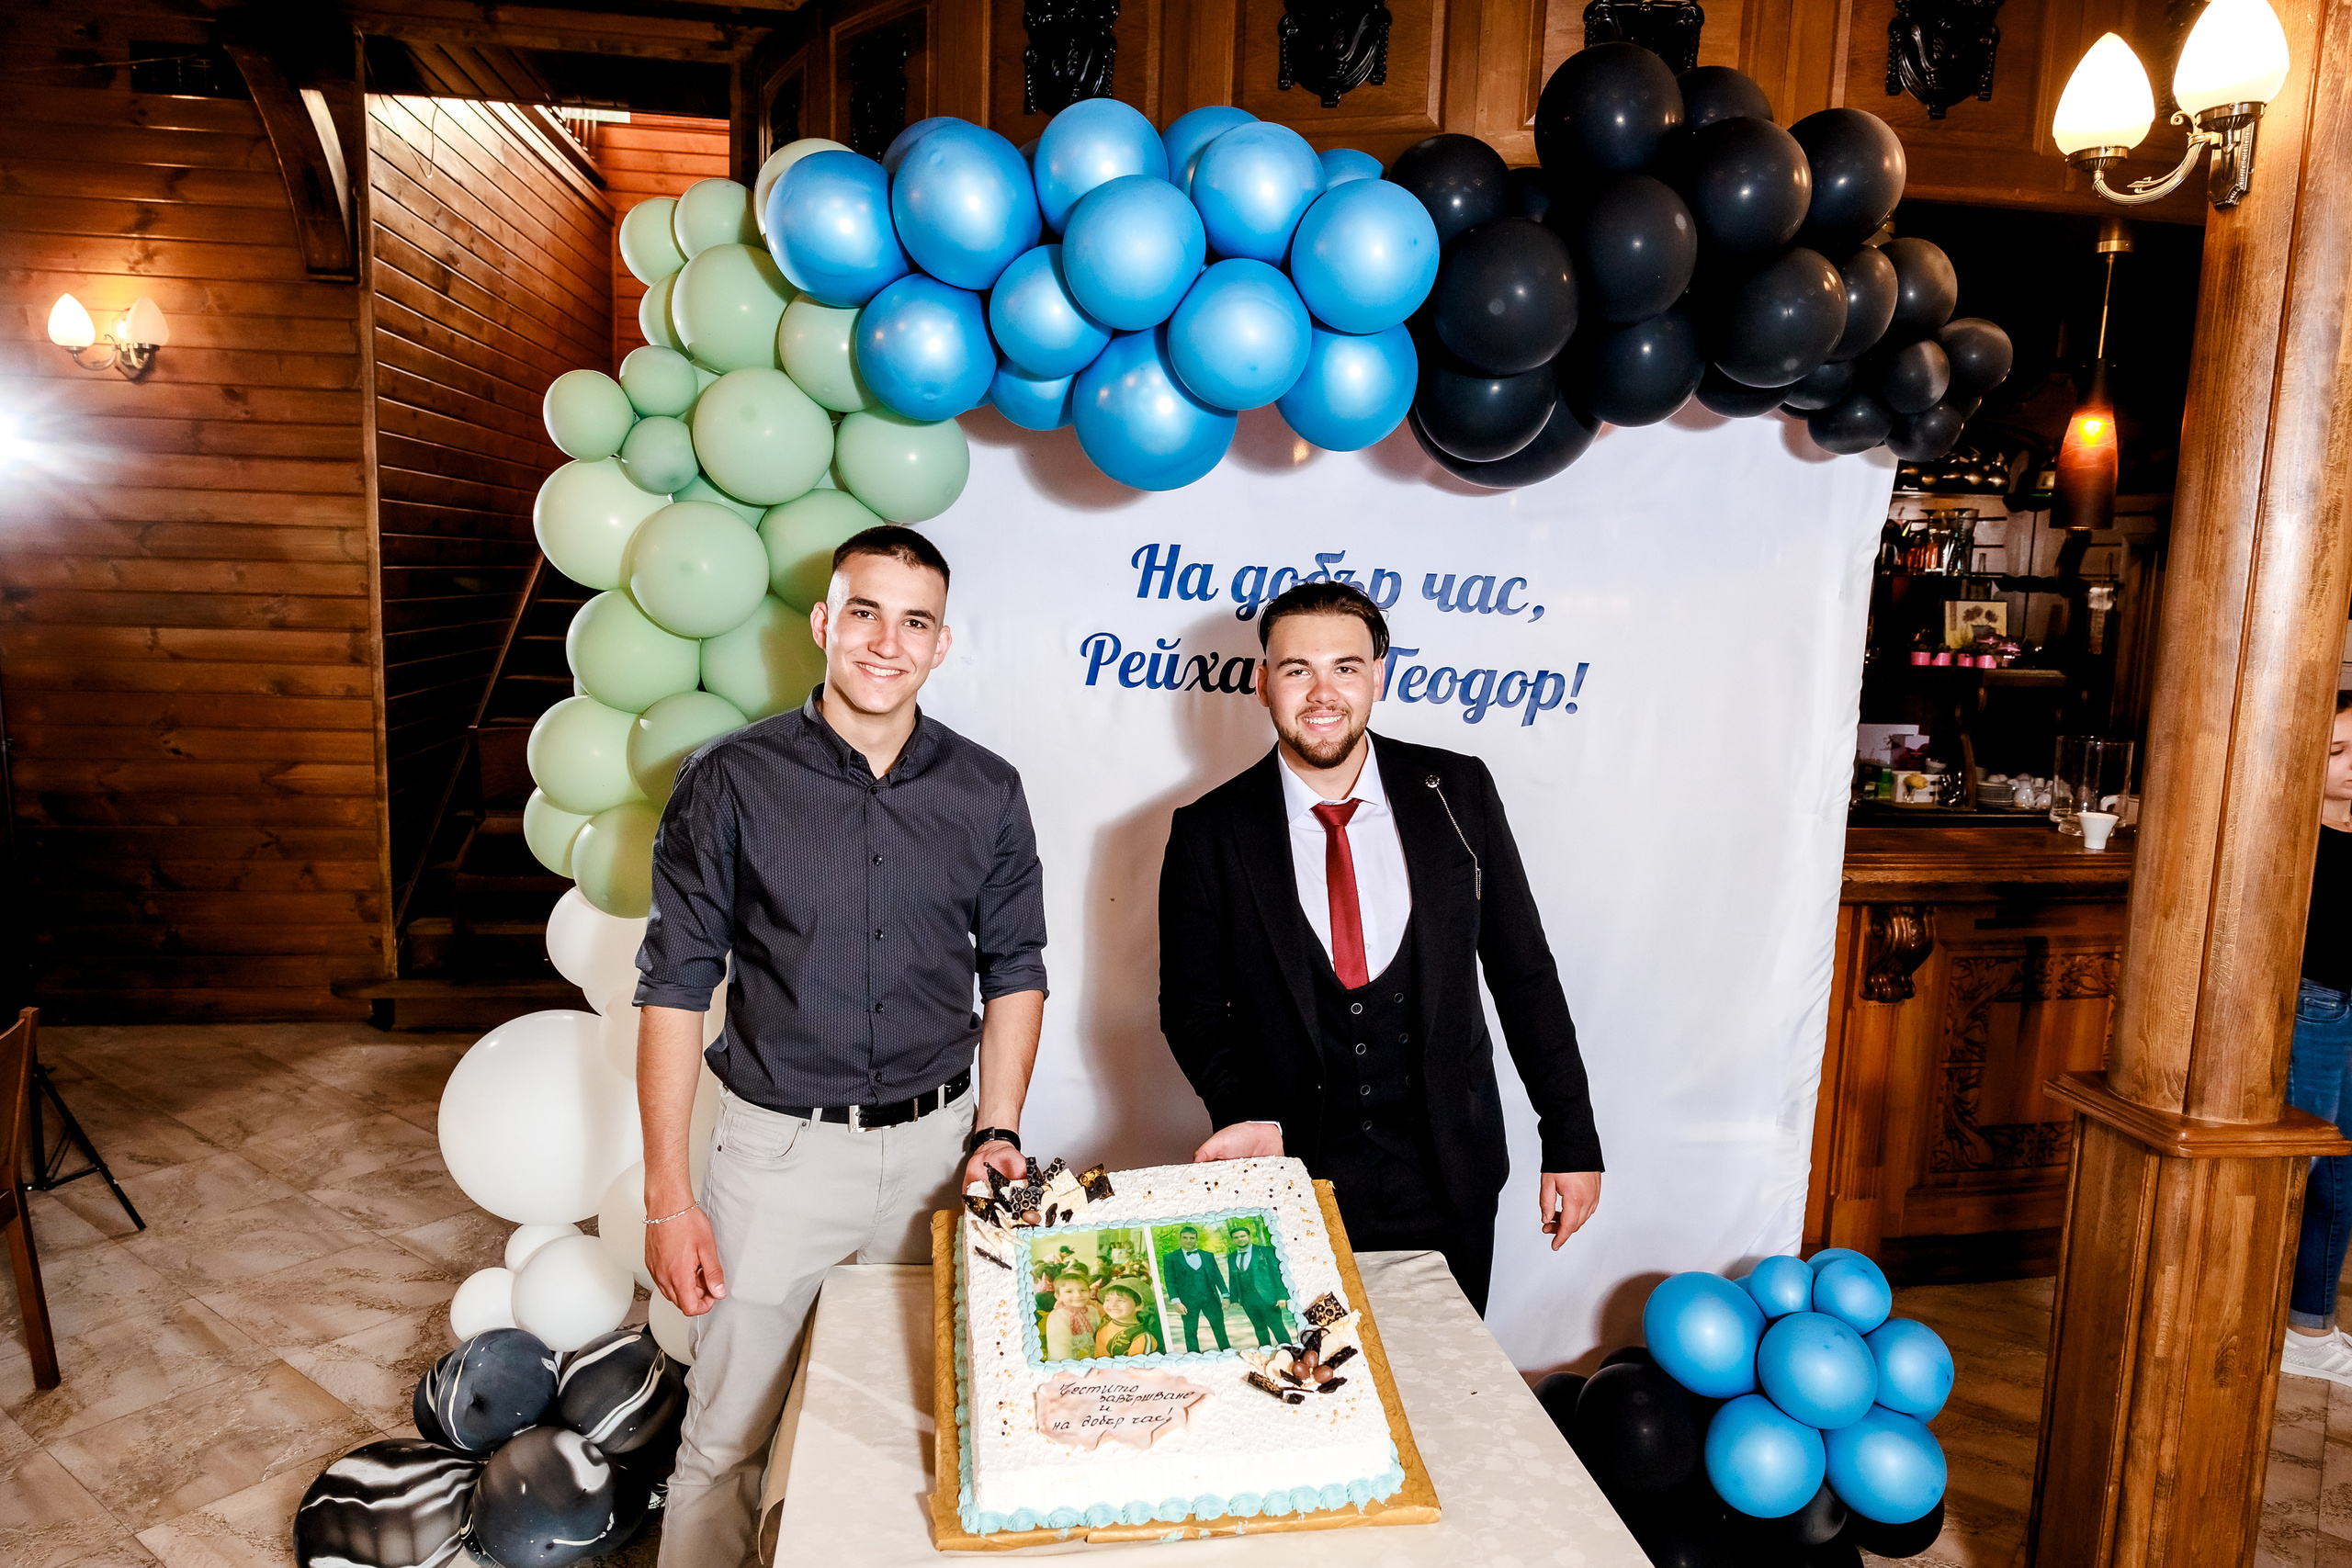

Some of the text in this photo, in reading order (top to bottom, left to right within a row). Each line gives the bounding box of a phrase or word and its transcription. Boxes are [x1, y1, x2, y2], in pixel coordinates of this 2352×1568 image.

[1130, 543, 1220, 602] На
[1421, 571, 1546, 624] час,
[1079, 631, 1591, 728] Рейха Теодор!
[1052, 1420, 1071, 1431] на
[1081, 1415, 1125, 1429] добър
[1099, 1404, 1112, 1413] и
